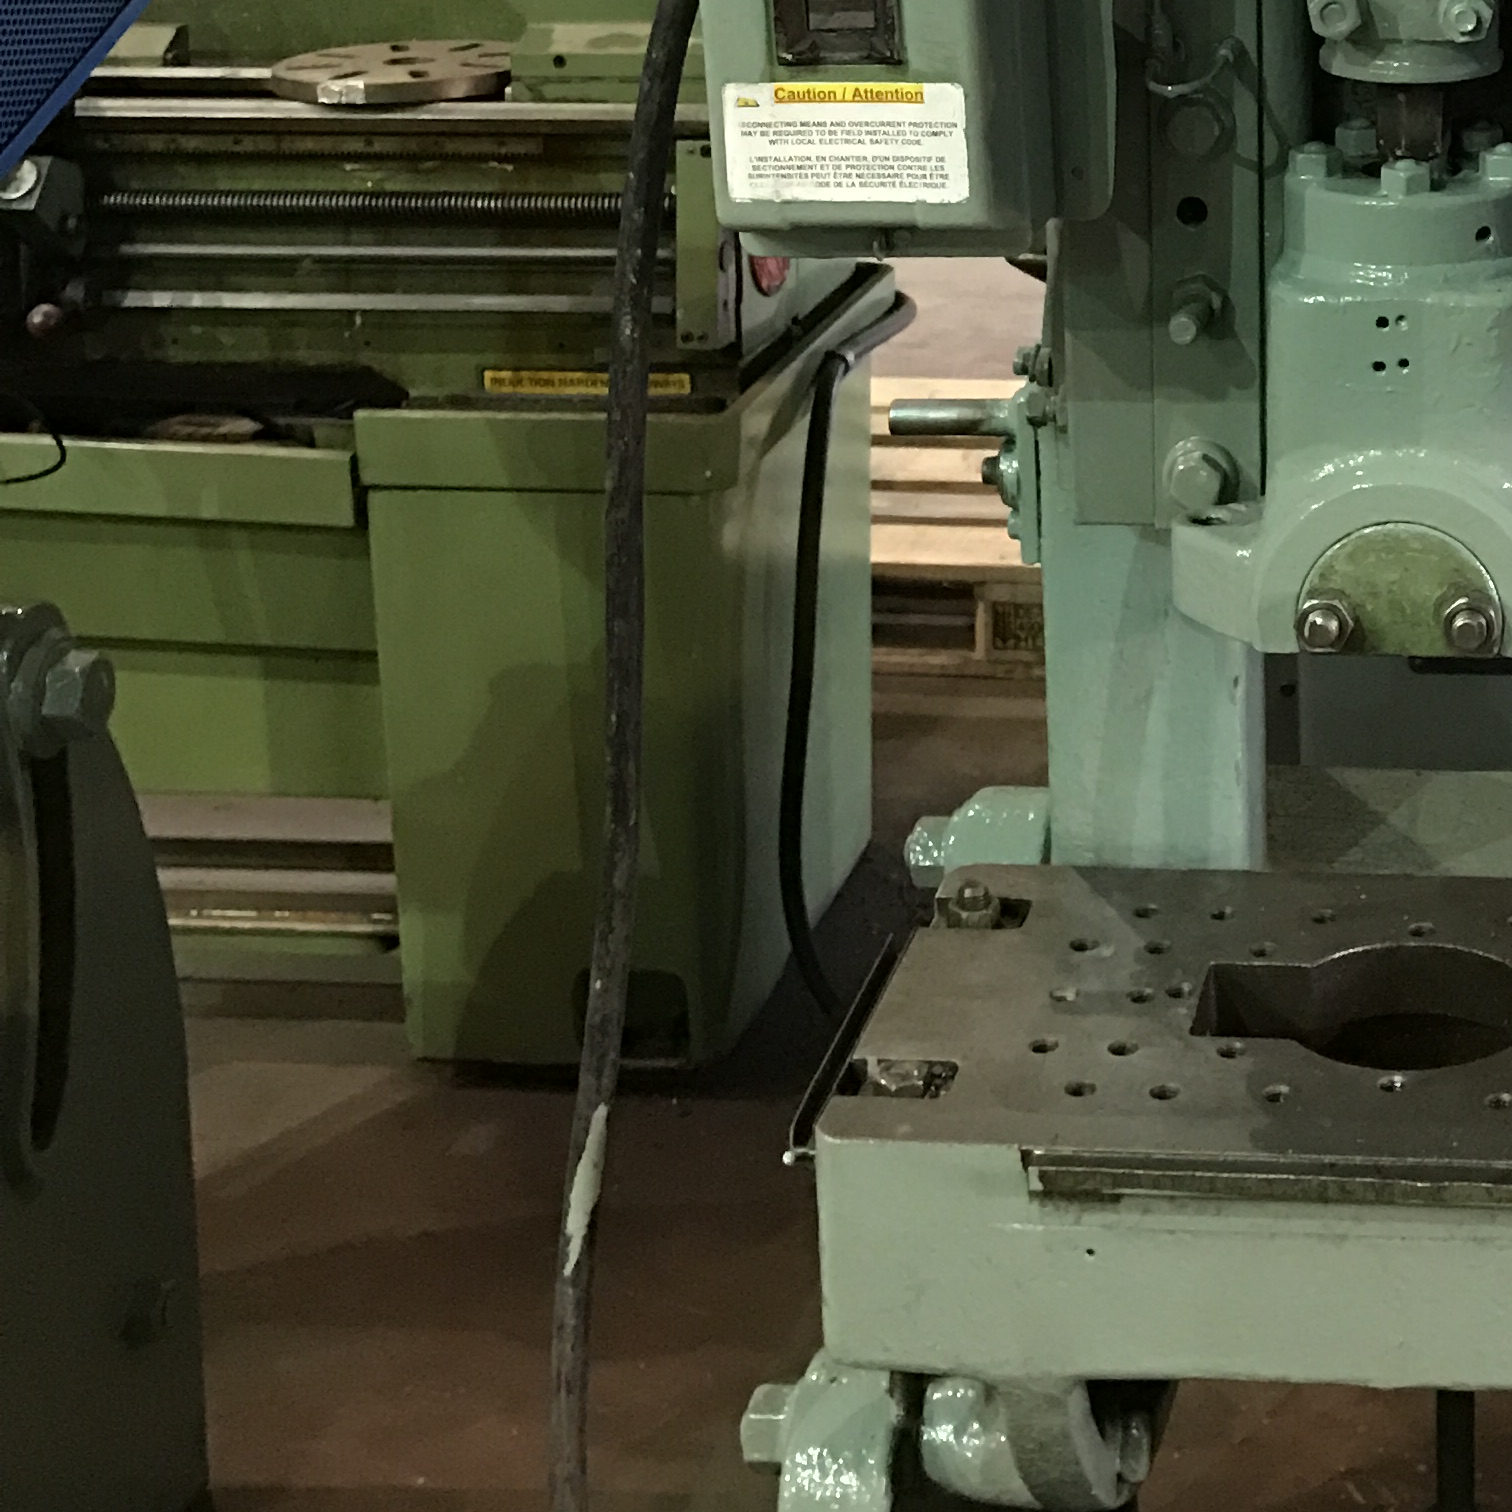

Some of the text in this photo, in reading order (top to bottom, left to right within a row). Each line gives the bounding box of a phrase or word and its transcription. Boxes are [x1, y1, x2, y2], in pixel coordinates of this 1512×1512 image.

[774, 87, 924, 102] Caution / Attention
[908, 121, 958, 129] PROTECTION
[815, 129, 826, 137] TO
[828, 129, 838, 137] BE
[840, 129, 863, 137] FIELD
[815, 155, 826, 163] EN
[929, 164, 945, 172] LES
